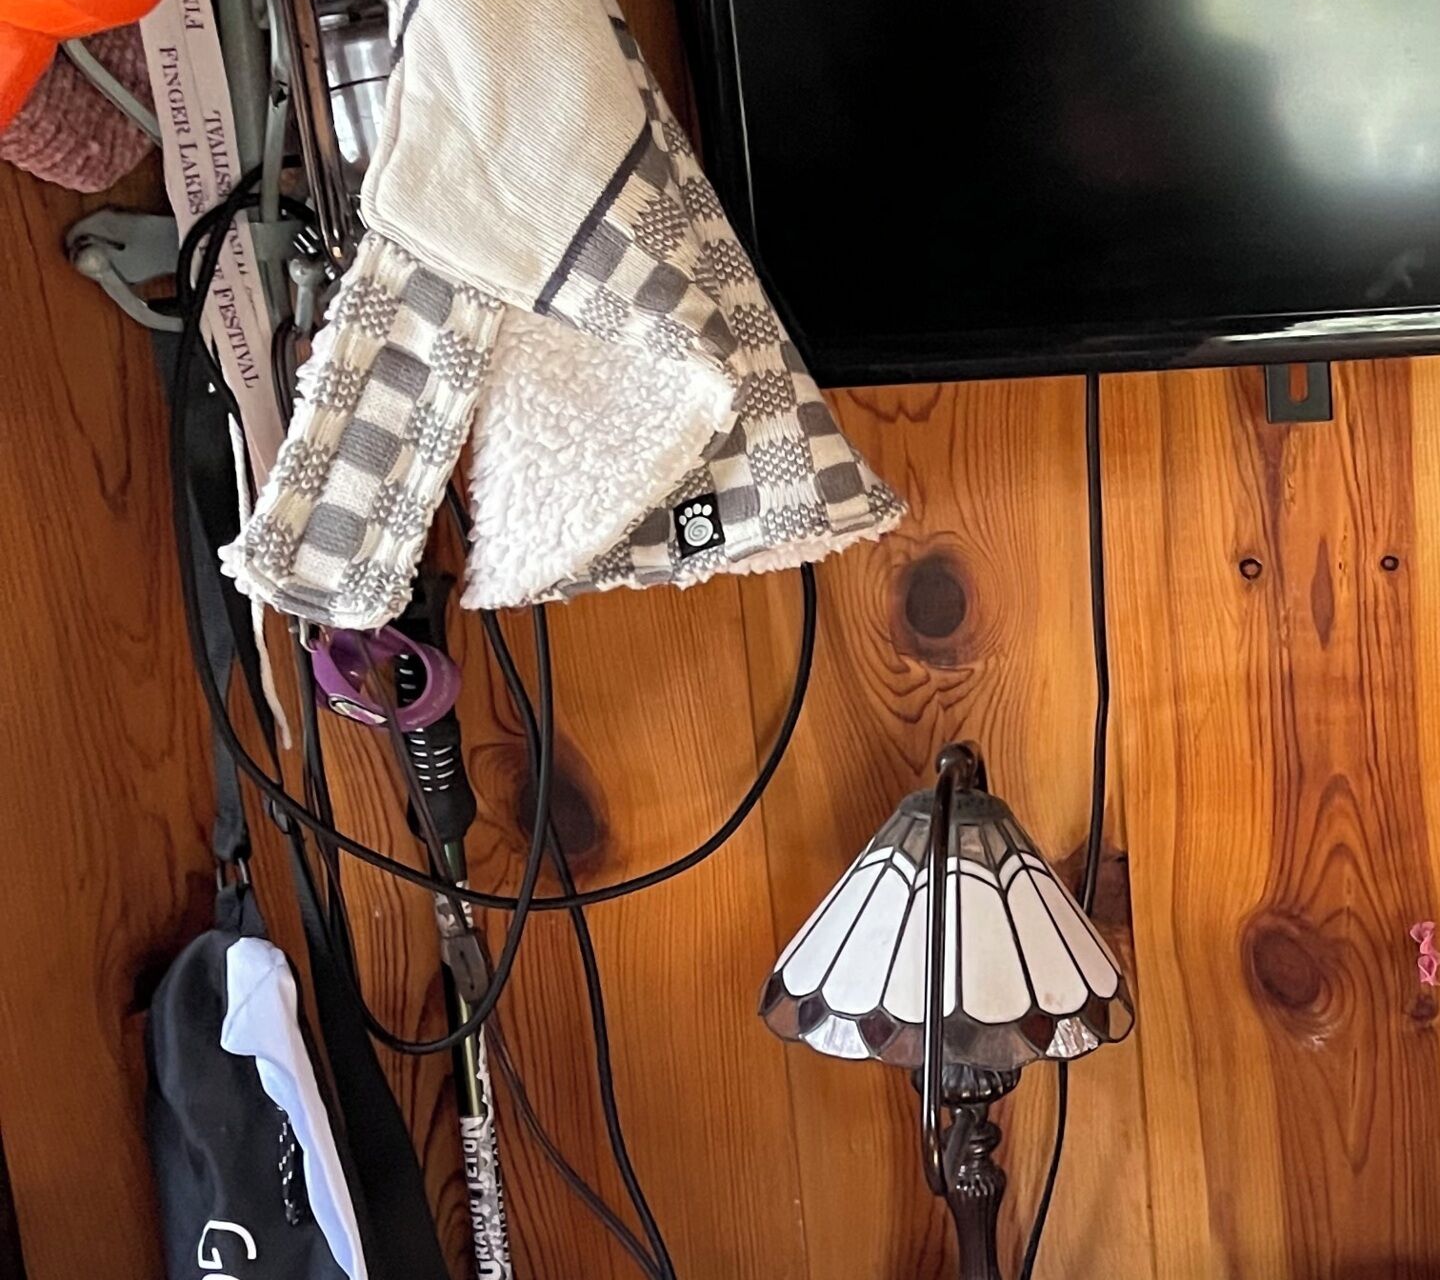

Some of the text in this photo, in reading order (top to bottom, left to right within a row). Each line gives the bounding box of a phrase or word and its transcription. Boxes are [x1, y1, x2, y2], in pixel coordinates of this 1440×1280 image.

[159, 45, 259, 389] FINGER LAKES FESTIVAL
[204, 109, 232, 197] ESTIVAL
